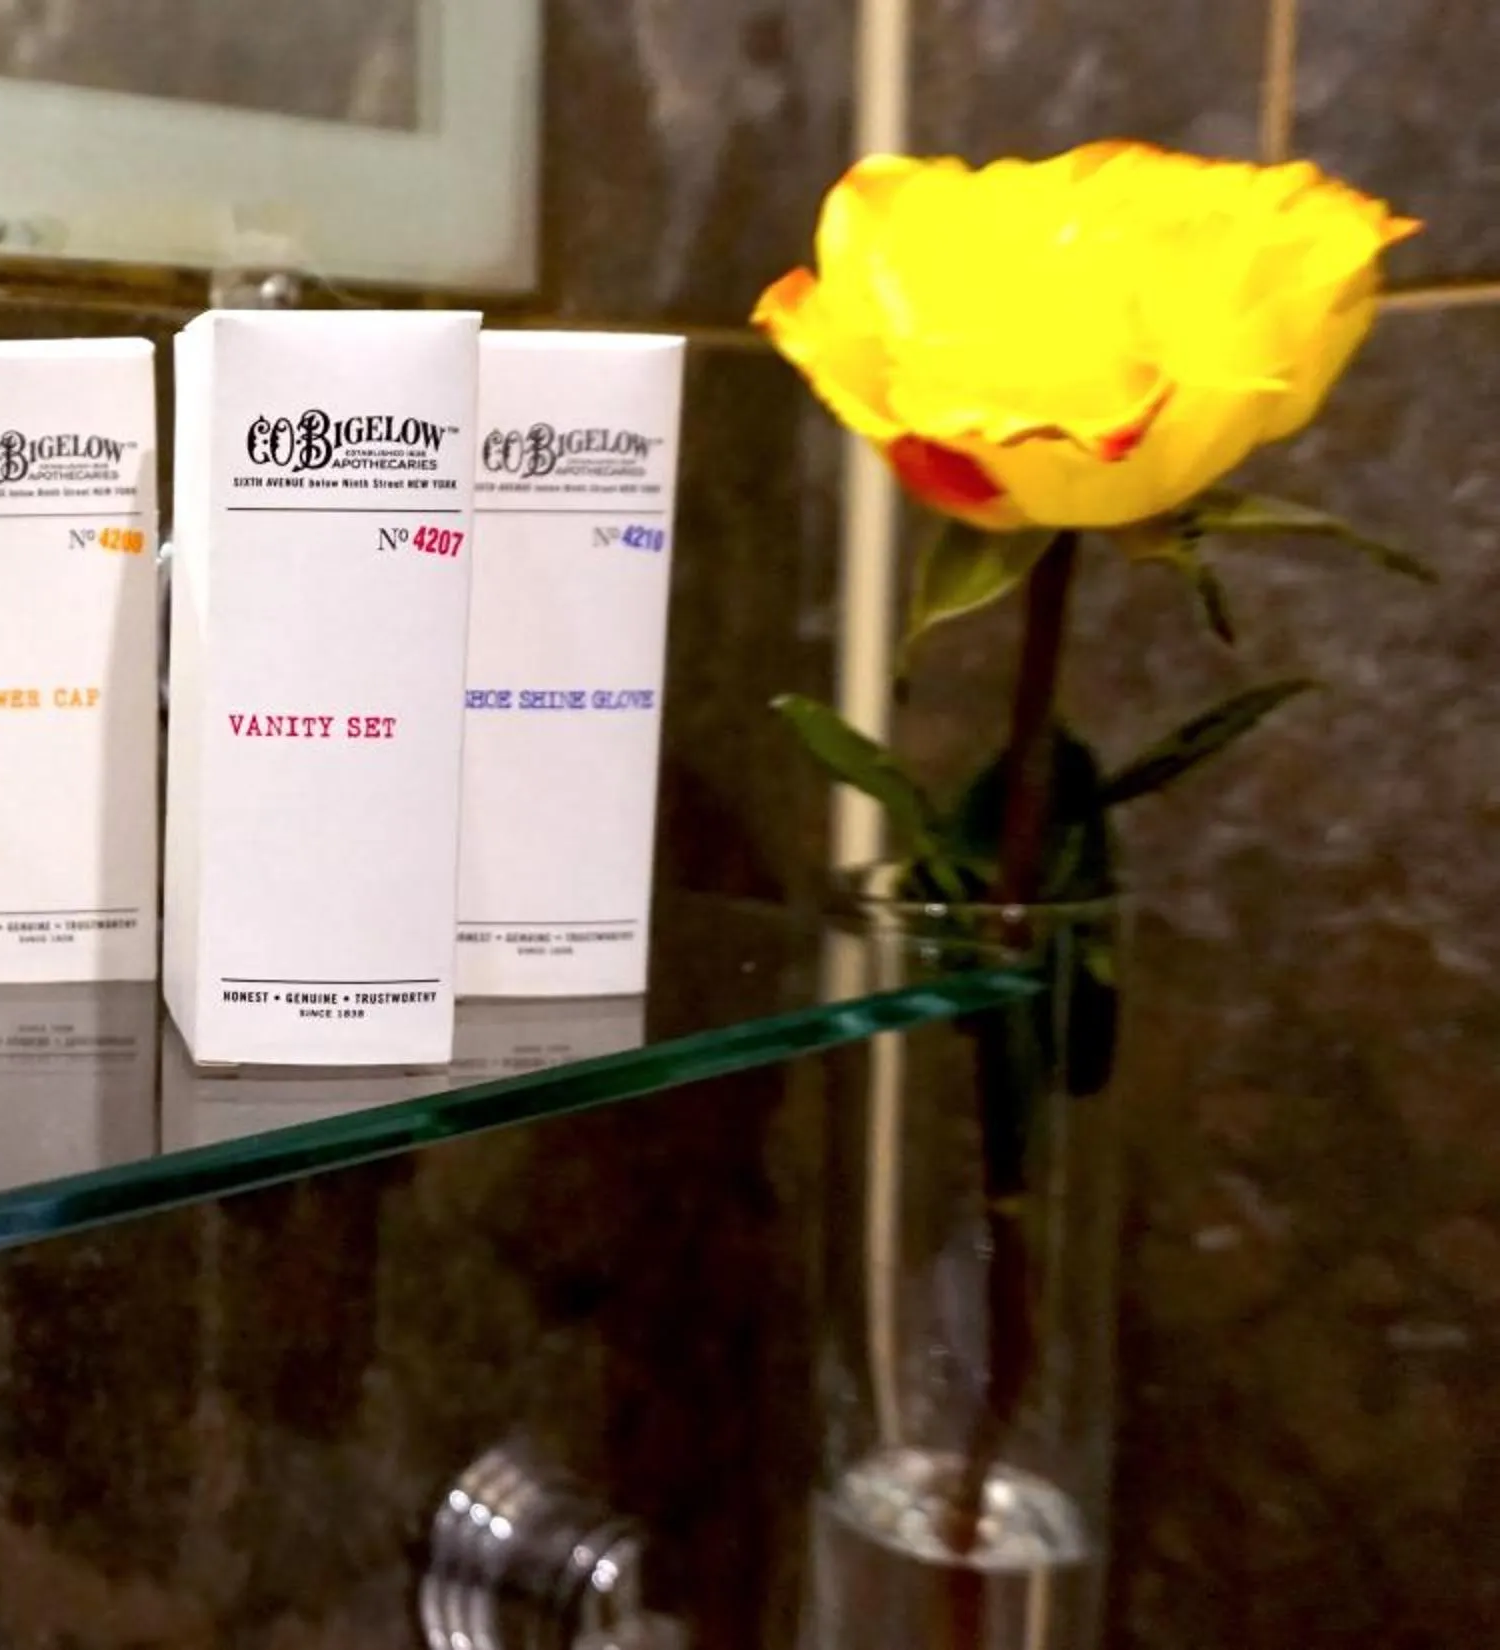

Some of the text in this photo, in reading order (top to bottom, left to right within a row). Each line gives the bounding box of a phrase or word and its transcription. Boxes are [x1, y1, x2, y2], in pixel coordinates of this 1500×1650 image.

[331, 458, 437, 471] APOTHECARIES
[233, 477, 458, 490] SIXTH AVENUE below Ninth Street NEW YORK
[412, 526, 464, 557] 4207
[53, 687, 102, 708] CAP
[519, 689, 587, 708] SHINE
[592, 689, 655, 709] GLOVE
[228, 715, 397, 738] VANITY SET
[223, 991, 437, 1005] HONEST GENUINE TRUSTWORTHY
[299, 1009, 332, 1018] SINCE
